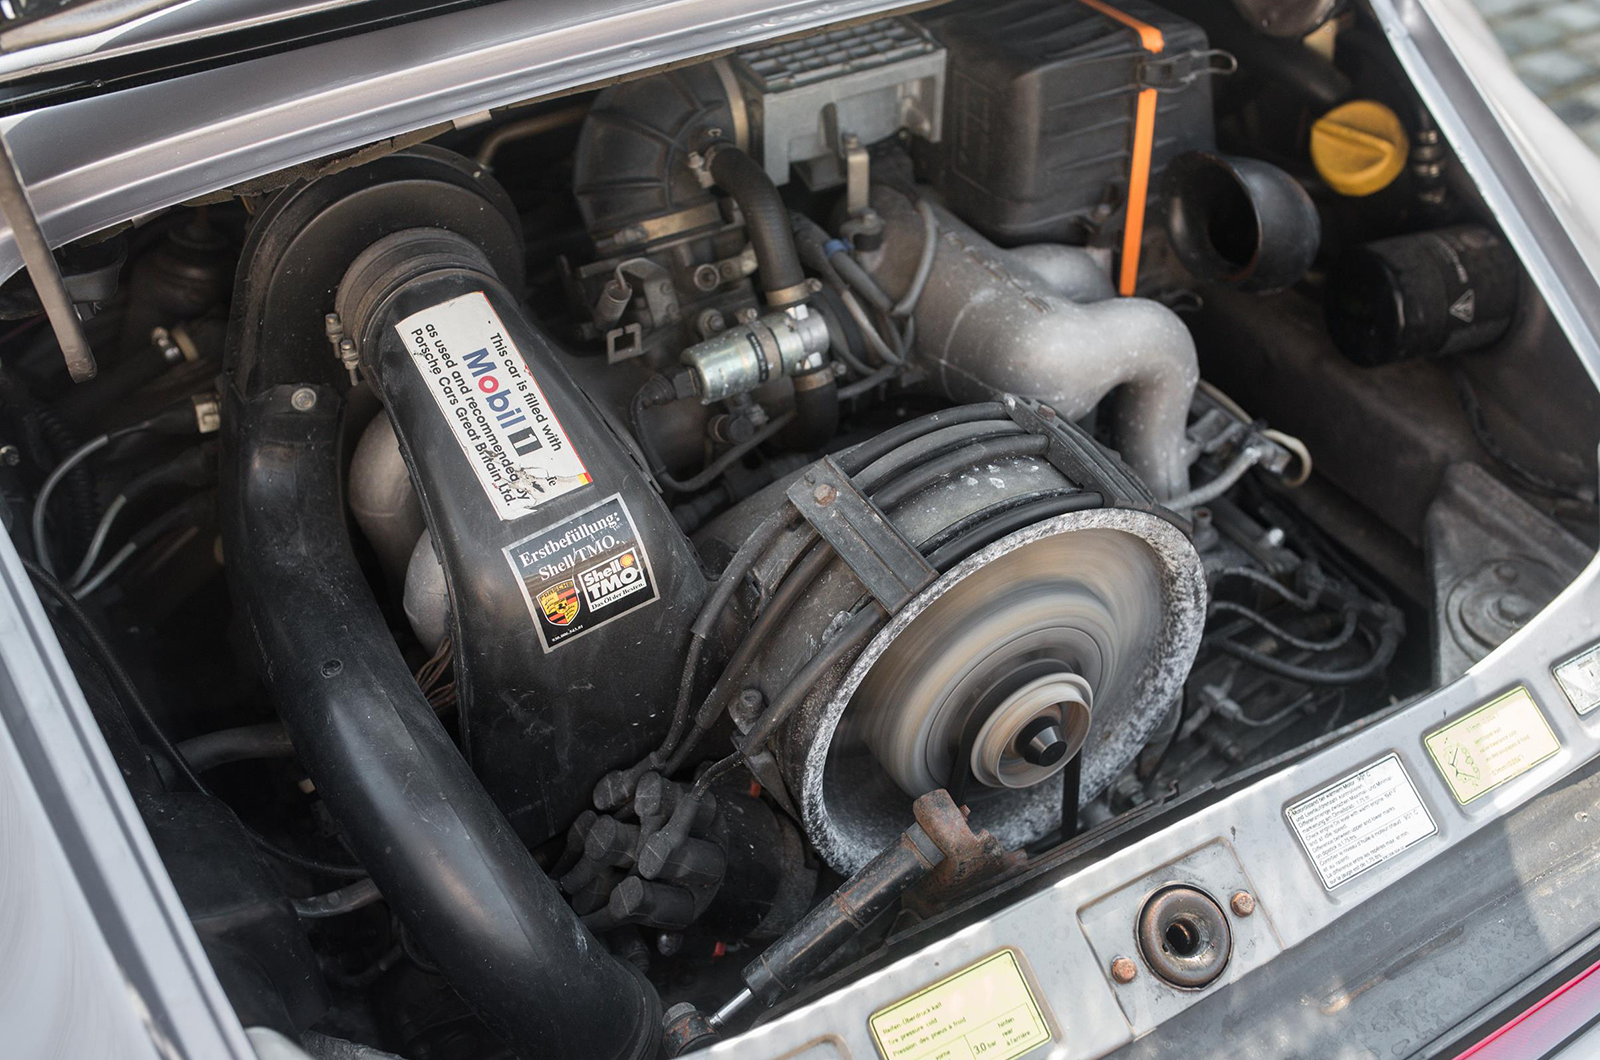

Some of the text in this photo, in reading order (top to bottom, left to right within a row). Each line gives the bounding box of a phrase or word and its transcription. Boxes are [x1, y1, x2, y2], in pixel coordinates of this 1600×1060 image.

[425, 323, 438, 337] as
[434, 339, 458, 368] used
[451, 370, 472, 394] and
[462, 347, 526, 428] Mobil
[490, 332, 561, 451] This car is filled with
[410, 327, 520, 506] Porsche Cars Great Britain Ltd.
[518, 512, 620, 567] Erstbefüllung:
[538, 535, 619, 581] Shell TMO.
[586, 563, 622, 586] Shell
[587, 566, 638, 599] TMO
[612, 592, 623, 601] der
[622, 583, 645, 597] Besten.
[1342, 780, 1354, 789] Motor
[1295, 814, 1304, 822] und
[1305, 831, 1319, 841] Check
[1318, 823, 1333, 834] engine
[1339, 814, 1350, 822] level
[1358, 803, 1369, 813] warm
[1369, 796, 1384, 806] engine
[1311, 839, 1333, 853] Difference
[1332, 829, 1350, 841] between
[1351, 822, 1363, 832] upper
[1371, 812, 1382, 821] lower
[1381, 805, 1395, 814] marks
[1308, 839, 1318, 847] and
[1321, 844, 1337, 856] dipstick
[1342, 843, 1357, 853] niveau
[1373, 824, 1388, 836] moteur
[1352, 855, 1363, 864] entre
[1329, 878, 1337, 886] sur
[1341, 869, 1353, 879] jauge
[1352, 864, 1360, 872] est
[930, 1001, 941, 1011] kalt
[888, 1017, 937, 1045] Tire pressure cold
[997, 1016, 1014, 1028] hinten
[1001, 1028, 1013, 1037] rear
[892, 1041, 916, 1056] Pression
[918, 1035, 929, 1044] des
[930, 1026, 947, 1039] pneus
[952, 1016, 966, 1027] froid
[987, 1040, 996, 1048] bar
